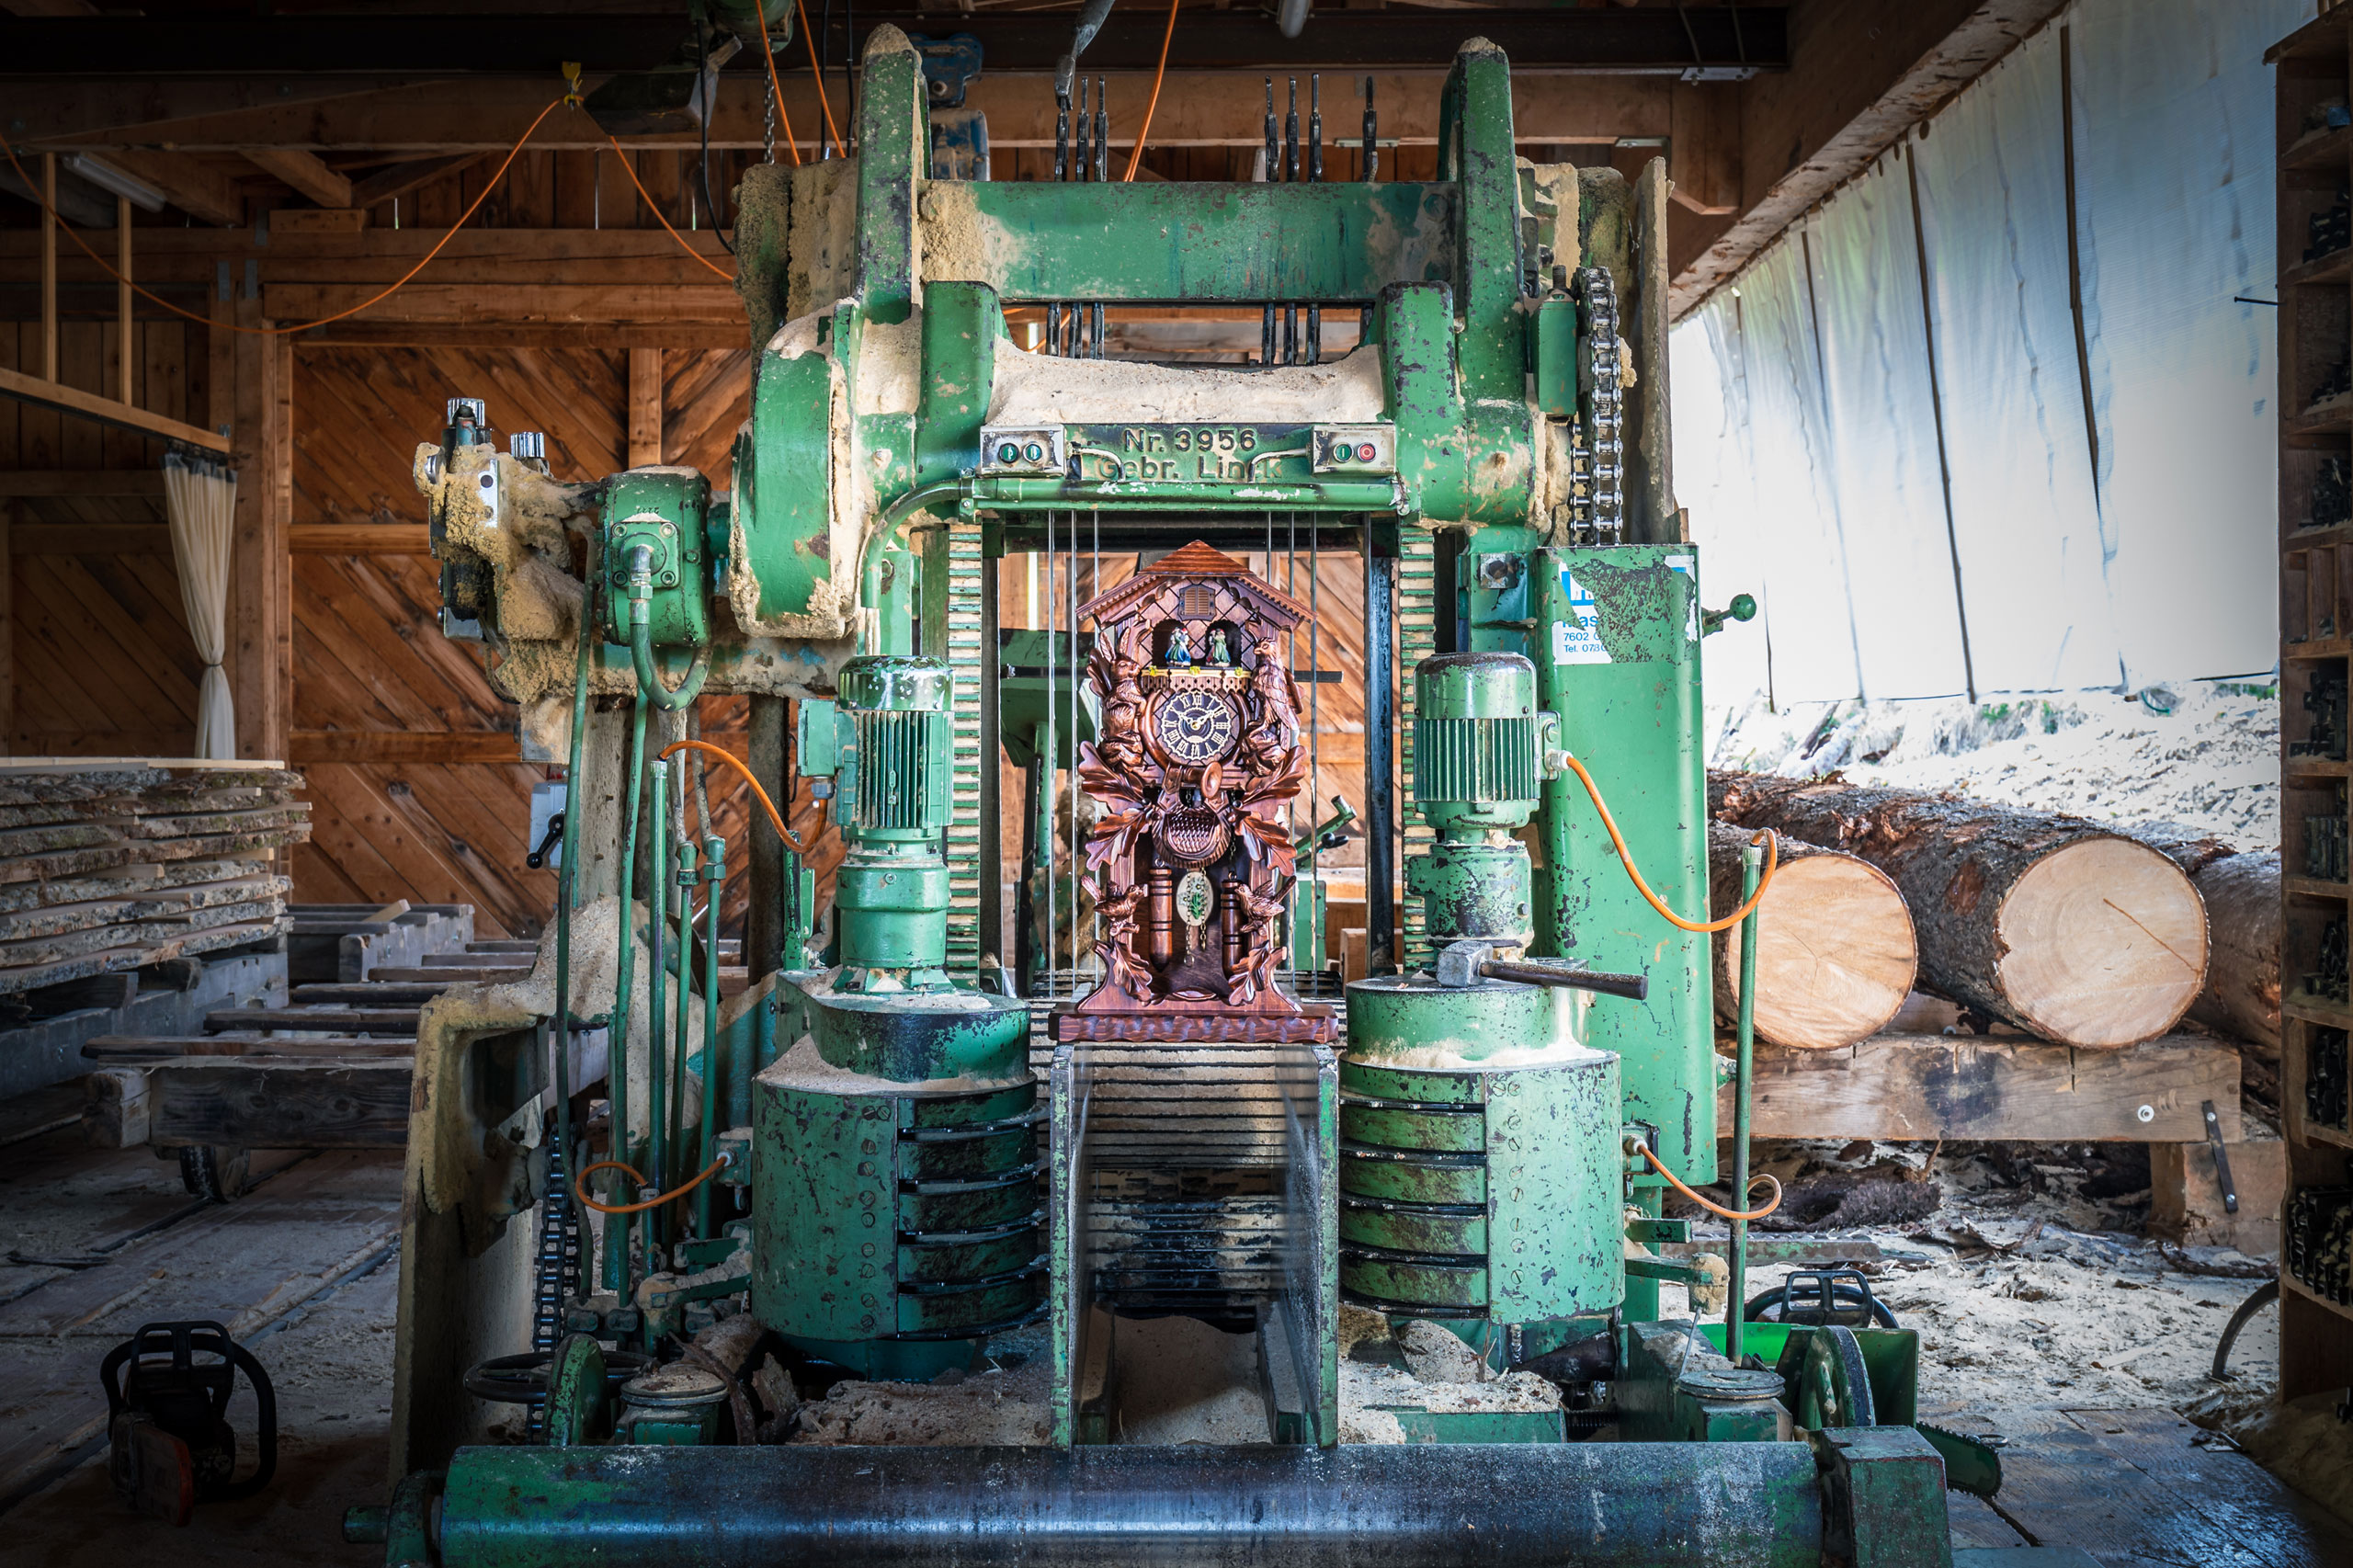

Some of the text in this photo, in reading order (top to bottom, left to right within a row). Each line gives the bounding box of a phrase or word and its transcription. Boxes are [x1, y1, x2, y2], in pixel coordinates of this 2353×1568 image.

[1124, 428, 1256, 452] Nr. 3956
[1099, 455, 1179, 479] Gebr.
[1563, 632, 1589, 642] 7602
